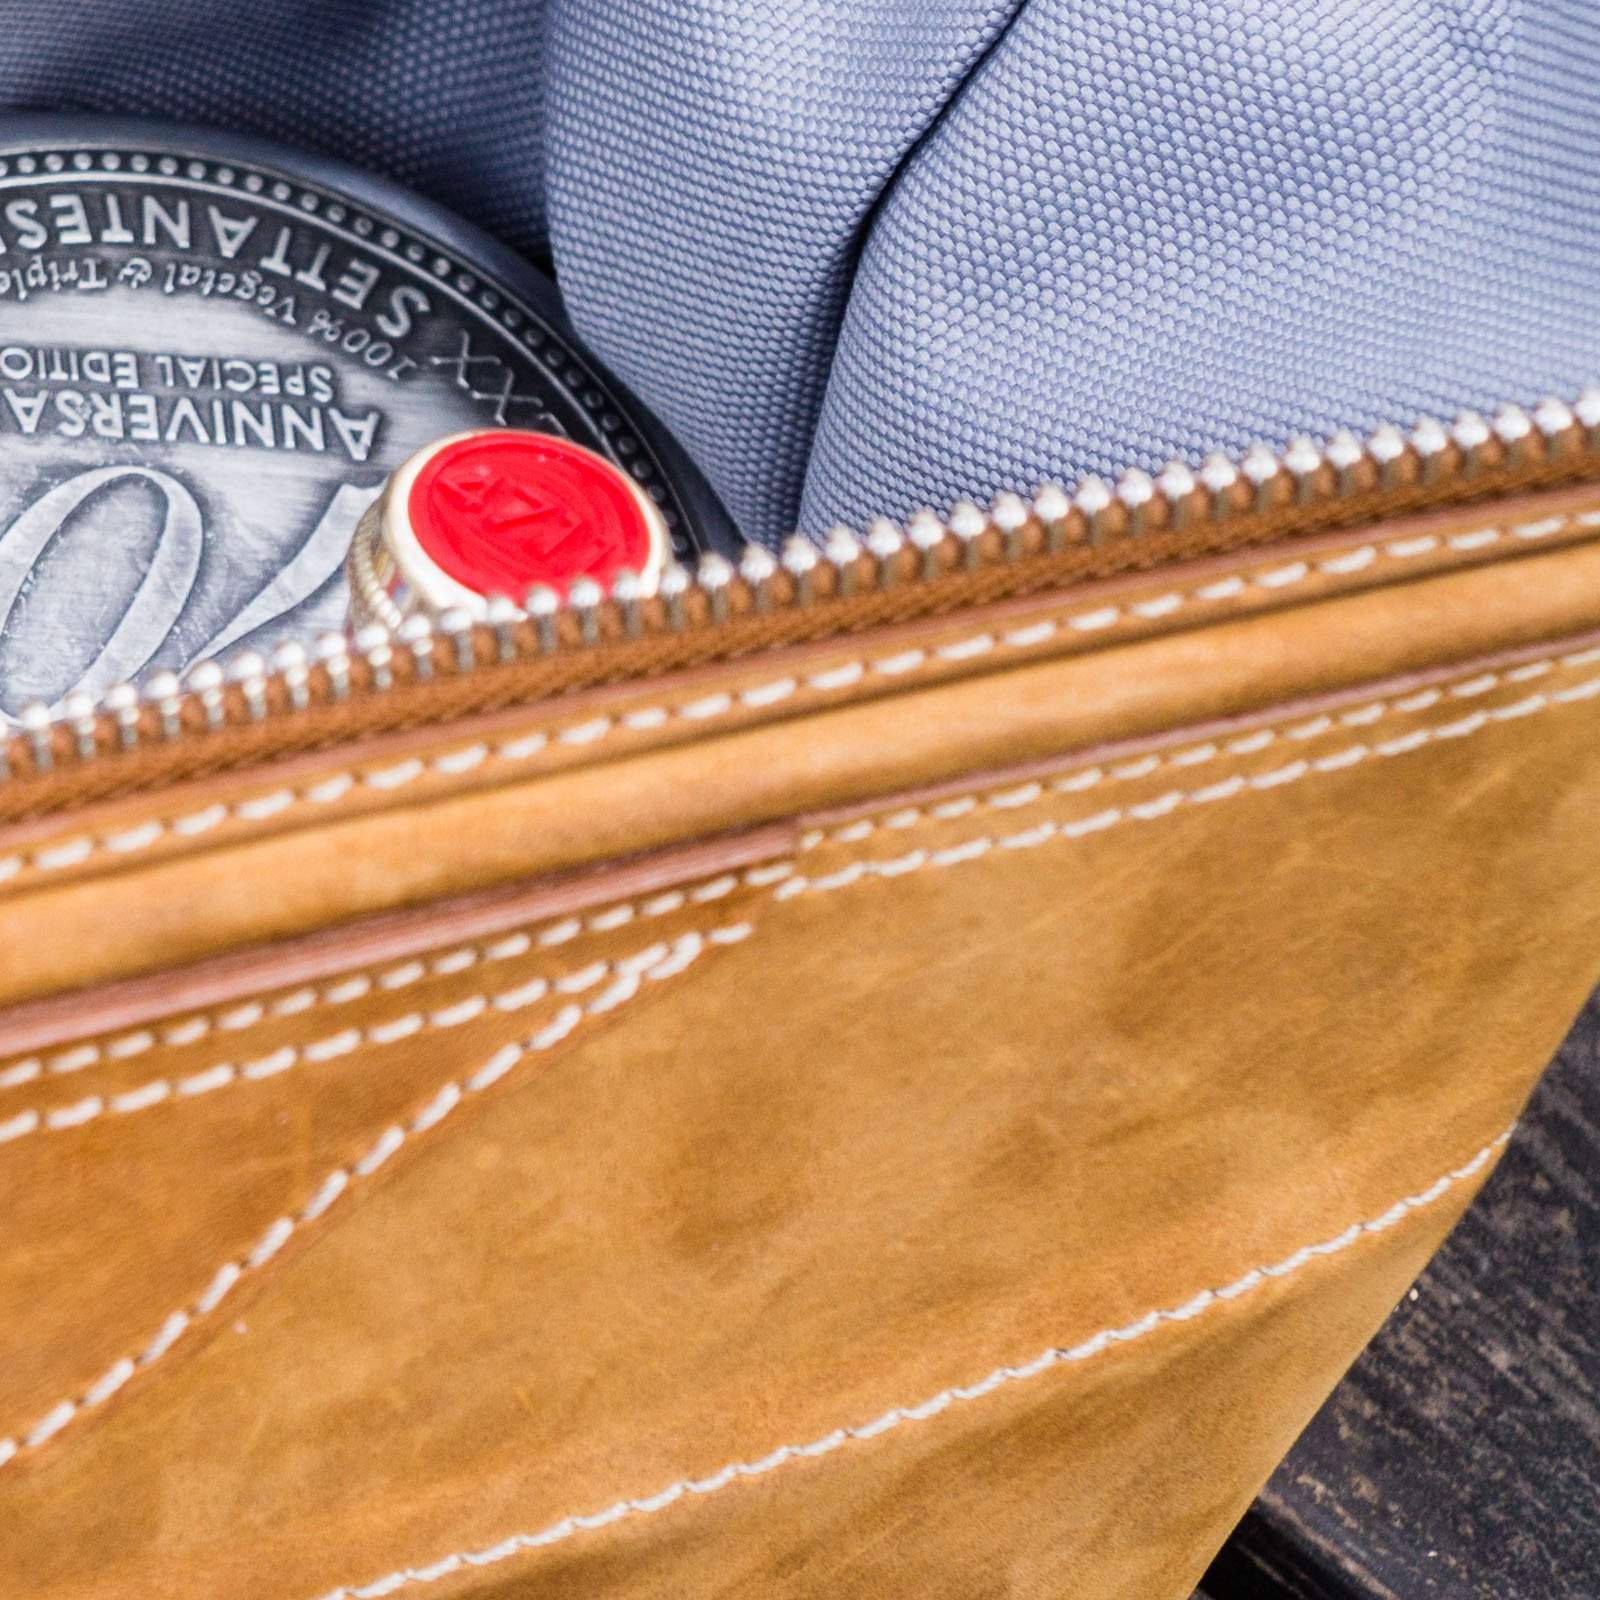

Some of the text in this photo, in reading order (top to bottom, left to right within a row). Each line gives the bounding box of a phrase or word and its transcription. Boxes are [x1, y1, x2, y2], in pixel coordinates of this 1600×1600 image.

[162, 260, 298, 326] Vegetal
[307, 306, 418, 381] 100%
[154, 353, 336, 404] SPECIAL
